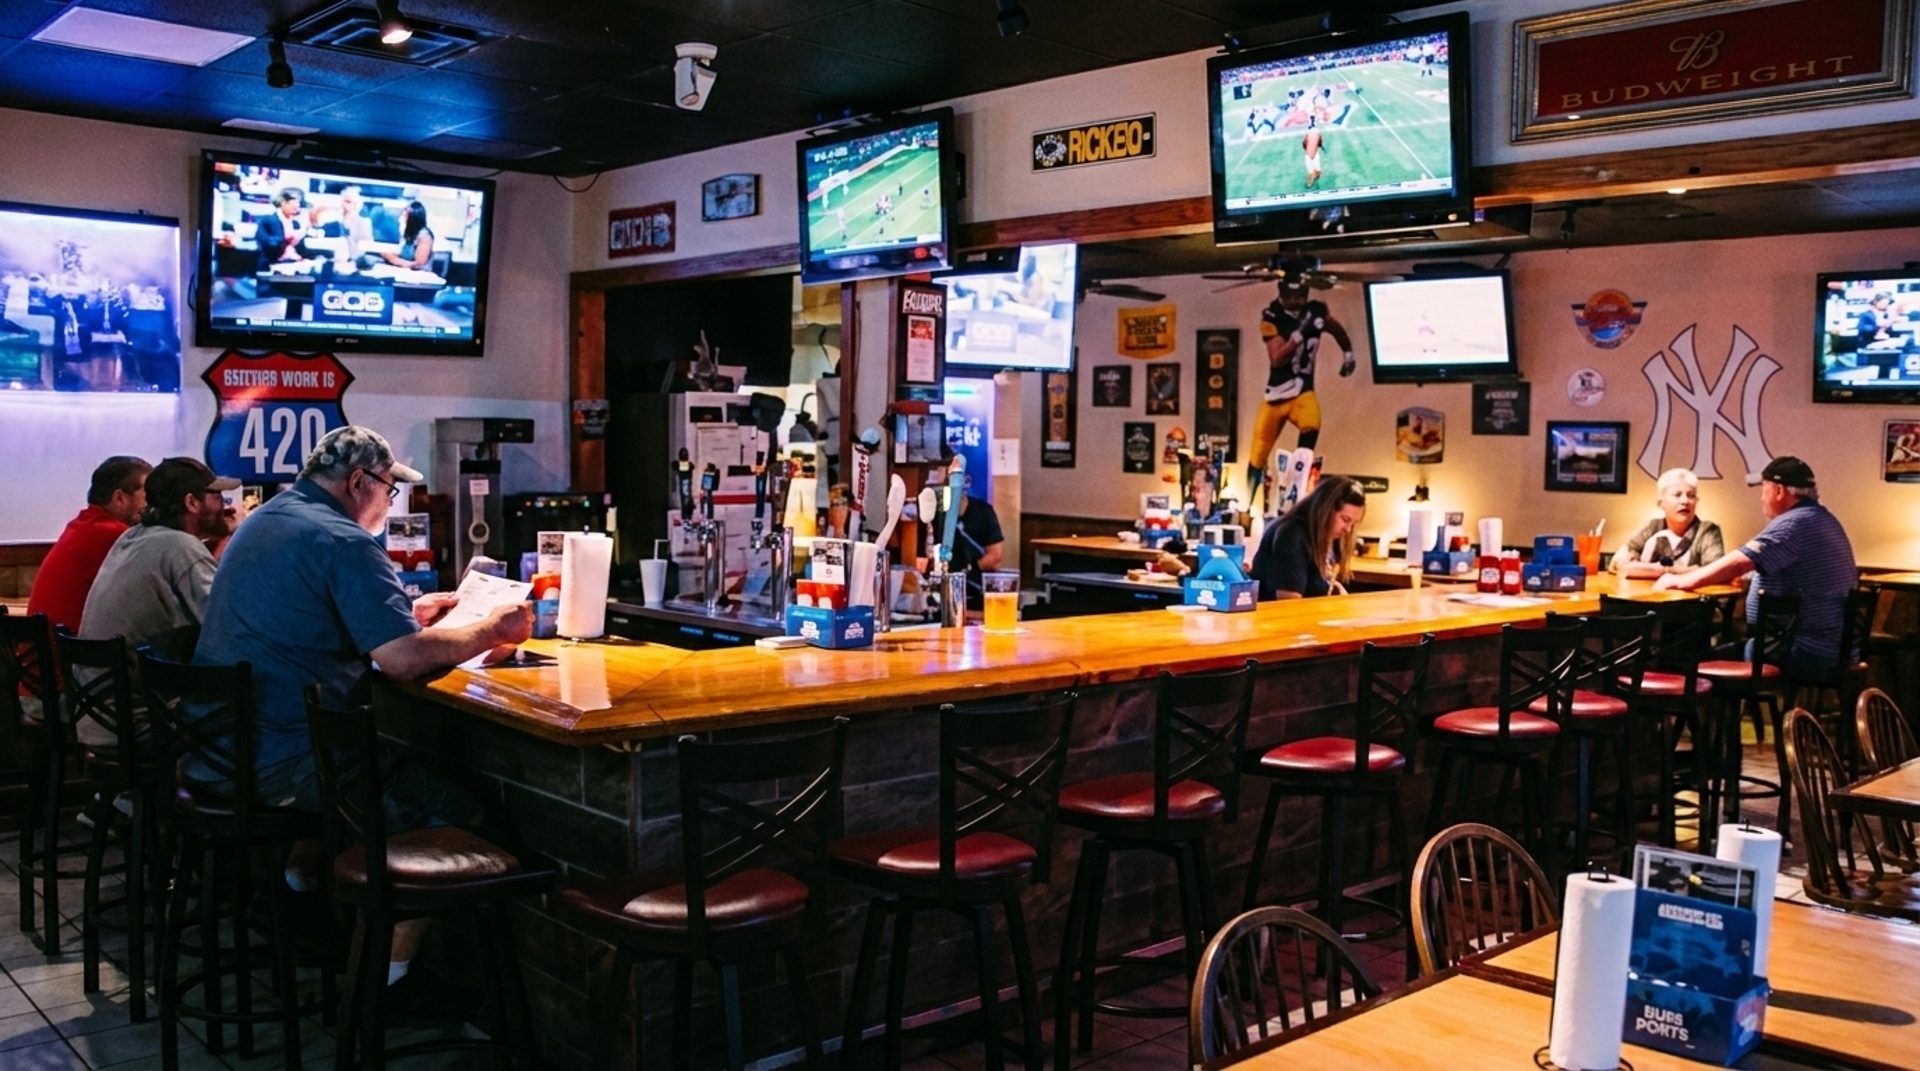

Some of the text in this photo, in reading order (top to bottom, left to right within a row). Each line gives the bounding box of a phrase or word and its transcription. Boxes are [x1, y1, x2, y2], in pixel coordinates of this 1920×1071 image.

[1561, 55, 1853, 109] BUDWEIGHT
[281, 370, 319, 388] WORK
[323, 371, 335, 388] IS
[1636, 322, 1784, 486] NY
